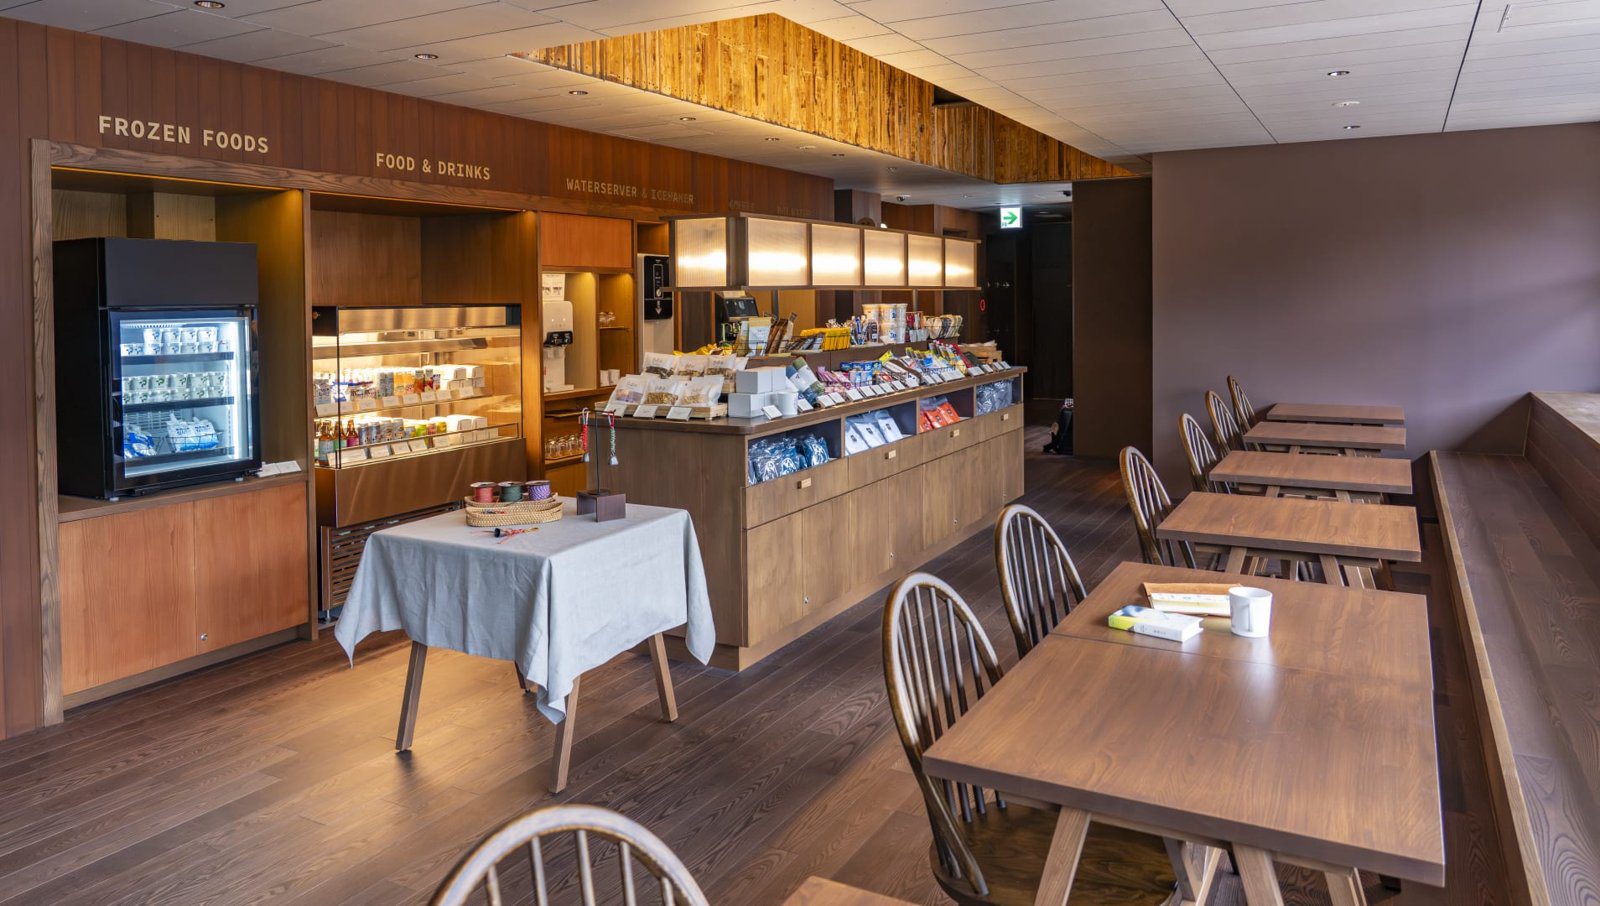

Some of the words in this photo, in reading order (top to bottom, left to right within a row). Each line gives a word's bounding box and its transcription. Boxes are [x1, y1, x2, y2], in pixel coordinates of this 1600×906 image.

[98, 115, 191, 145] FROZEN
[203, 129, 269, 154] FOODS
[376, 152, 415, 172] FOOD
[422, 158, 431, 173] &
[438, 161, 491, 181] DRINKS
[566, 177, 637, 198] WATERSERVER
